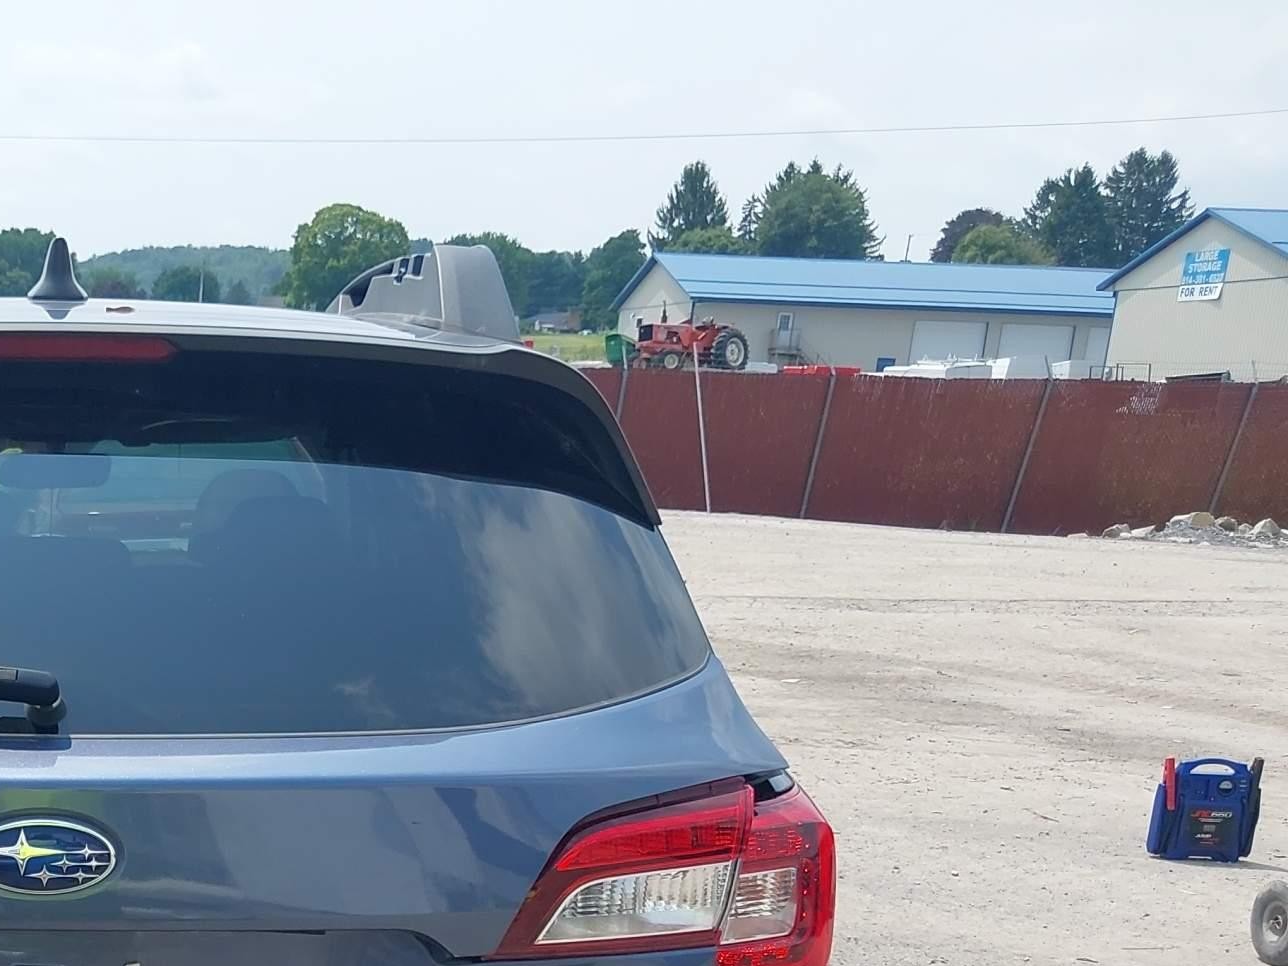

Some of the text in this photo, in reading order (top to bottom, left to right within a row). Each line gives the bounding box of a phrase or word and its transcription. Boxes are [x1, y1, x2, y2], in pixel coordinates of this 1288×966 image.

[1194, 250, 1220, 262] LARGE
[1188, 260, 1223, 274] STORAGE
[1180, 286, 1219, 298] FOR RENT
